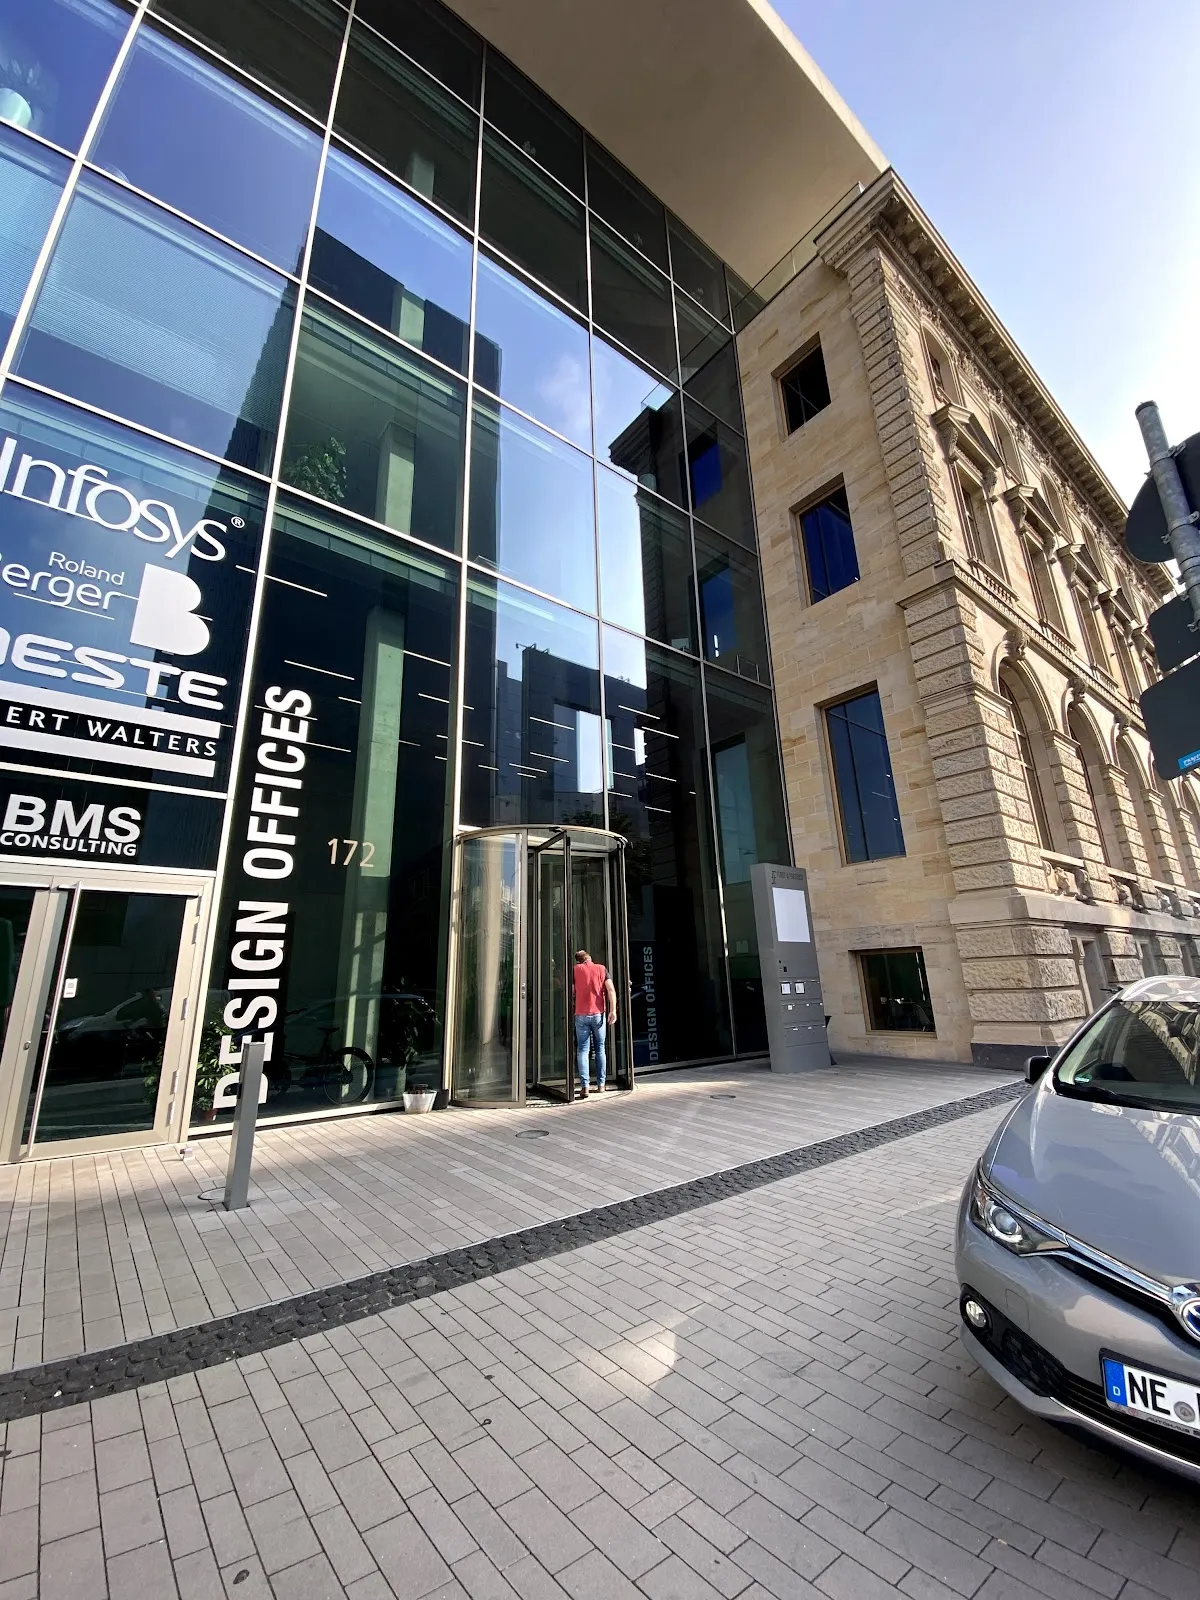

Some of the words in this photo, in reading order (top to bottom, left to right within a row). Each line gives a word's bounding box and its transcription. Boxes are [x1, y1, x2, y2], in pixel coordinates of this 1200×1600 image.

[0, 553, 122, 607] erger
[49, 552, 124, 586] Roland
[0, 626, 227, 711] ESTE
[87, 720, 217, 757] WALTERS
[243, 685, 312, 880] OFFICES
[0, 832, 137, 856] CONSULTING
[2, 793, 141, 843] BMS
[327, 838, 376, 868] 172
[643, 946, 656, 1003] OFFICES
[213, 901, 290, 1109] DESIGN
[647, 1007, 659, 1061] DESIGN
[1112, 1385, 1121, 1397] D
